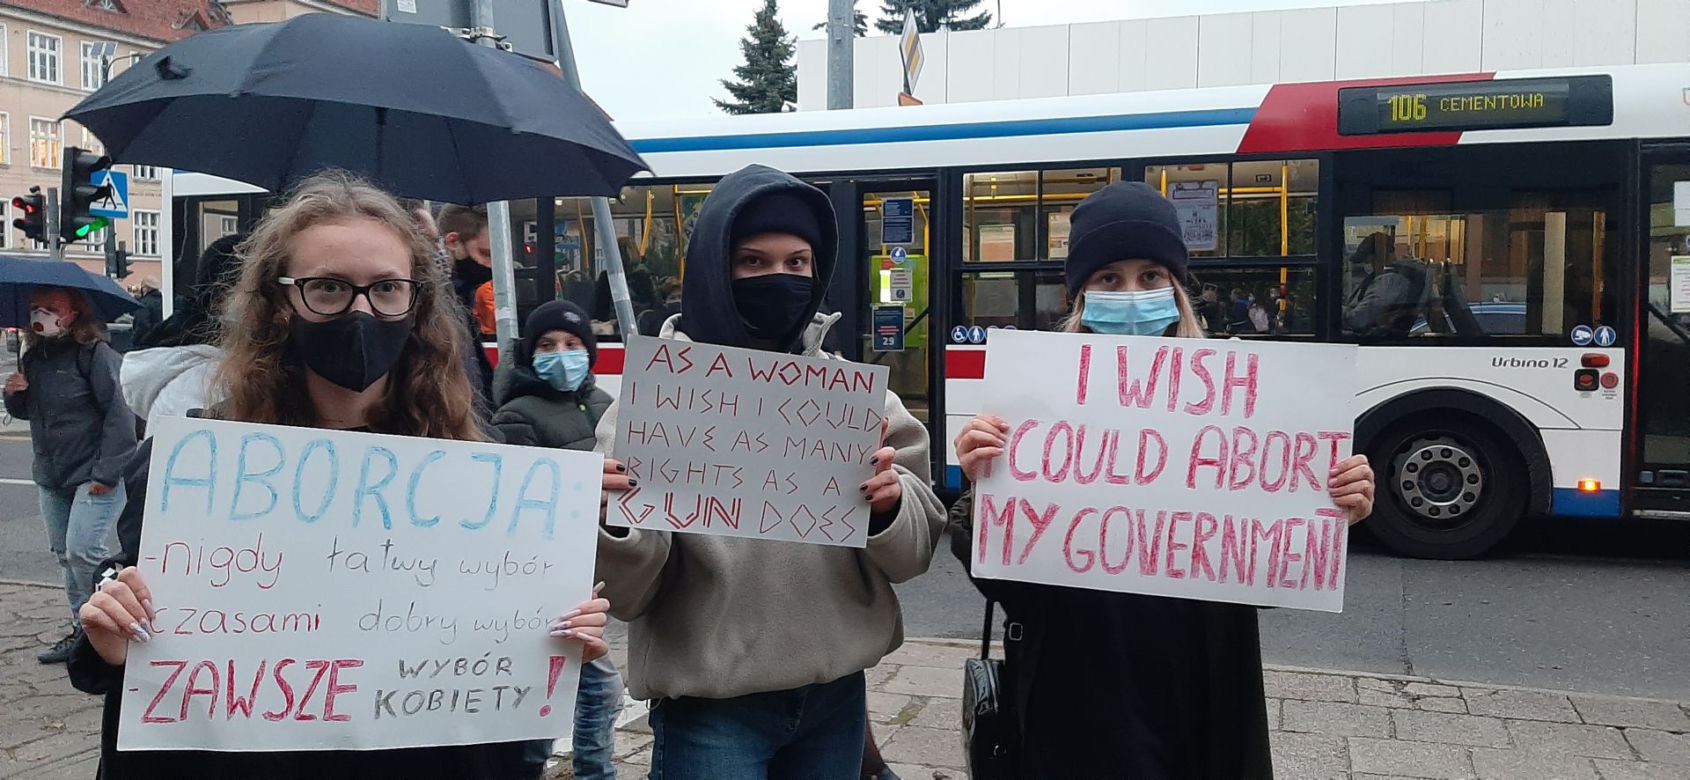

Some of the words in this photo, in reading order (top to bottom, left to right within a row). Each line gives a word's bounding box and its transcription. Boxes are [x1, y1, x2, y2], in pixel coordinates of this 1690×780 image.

[1387, 94, 1427, 121] 106
[1440, 93, 1544, 112] CEMENTOWA
[882, 336, 895, 346] 29
[1491, 357, 1549, 368] Urbino
[1552, 357, 1569, 368] 12
[645, 344, 693, 374] AS
[705, 352, 733, 378] A
[748, 356, 875, 394] WOMAN
[1076, 344, 1092, 405] I
[1116, 345, 1260, 418] WISH
[630, 381, 636, 405] I
[655, 384, 739, 416] WISH
[757, 397, 763, 416] I
[777, 398, 882, 432] COULD
[627, 420, 716, 452] HAVE
[730, 429, 769, 452] AS
[783, 436, 872, 465] MANY
[1008, 418, 1169, 486] COULD
[1186, 424, 1352, 493] ABORT
[161, 428, 585, 540] ABORCJA:
[626, 456, 743, 489] RIGHTS
[762, 469, 798, 494] AS
[823, 476, 840, 496] A
[617, 486, 742, 530] GUN
[759, 500, 857, 543] DOES
[327, 535, 438, 588] łatwy
[459, 550, 554, 591] wybór
[980, 493, 1061, 566] MY
[1061, 505, 1346, 591] GOVERNMENT
[150, 604, 322, 635] czasami
[358, 598, 457, 645] dobry
[473, 605, 557, 644] wybór
[398, 651, 513, 679] WYBÓR
[374, 685, 532, 720] KOBIETY
